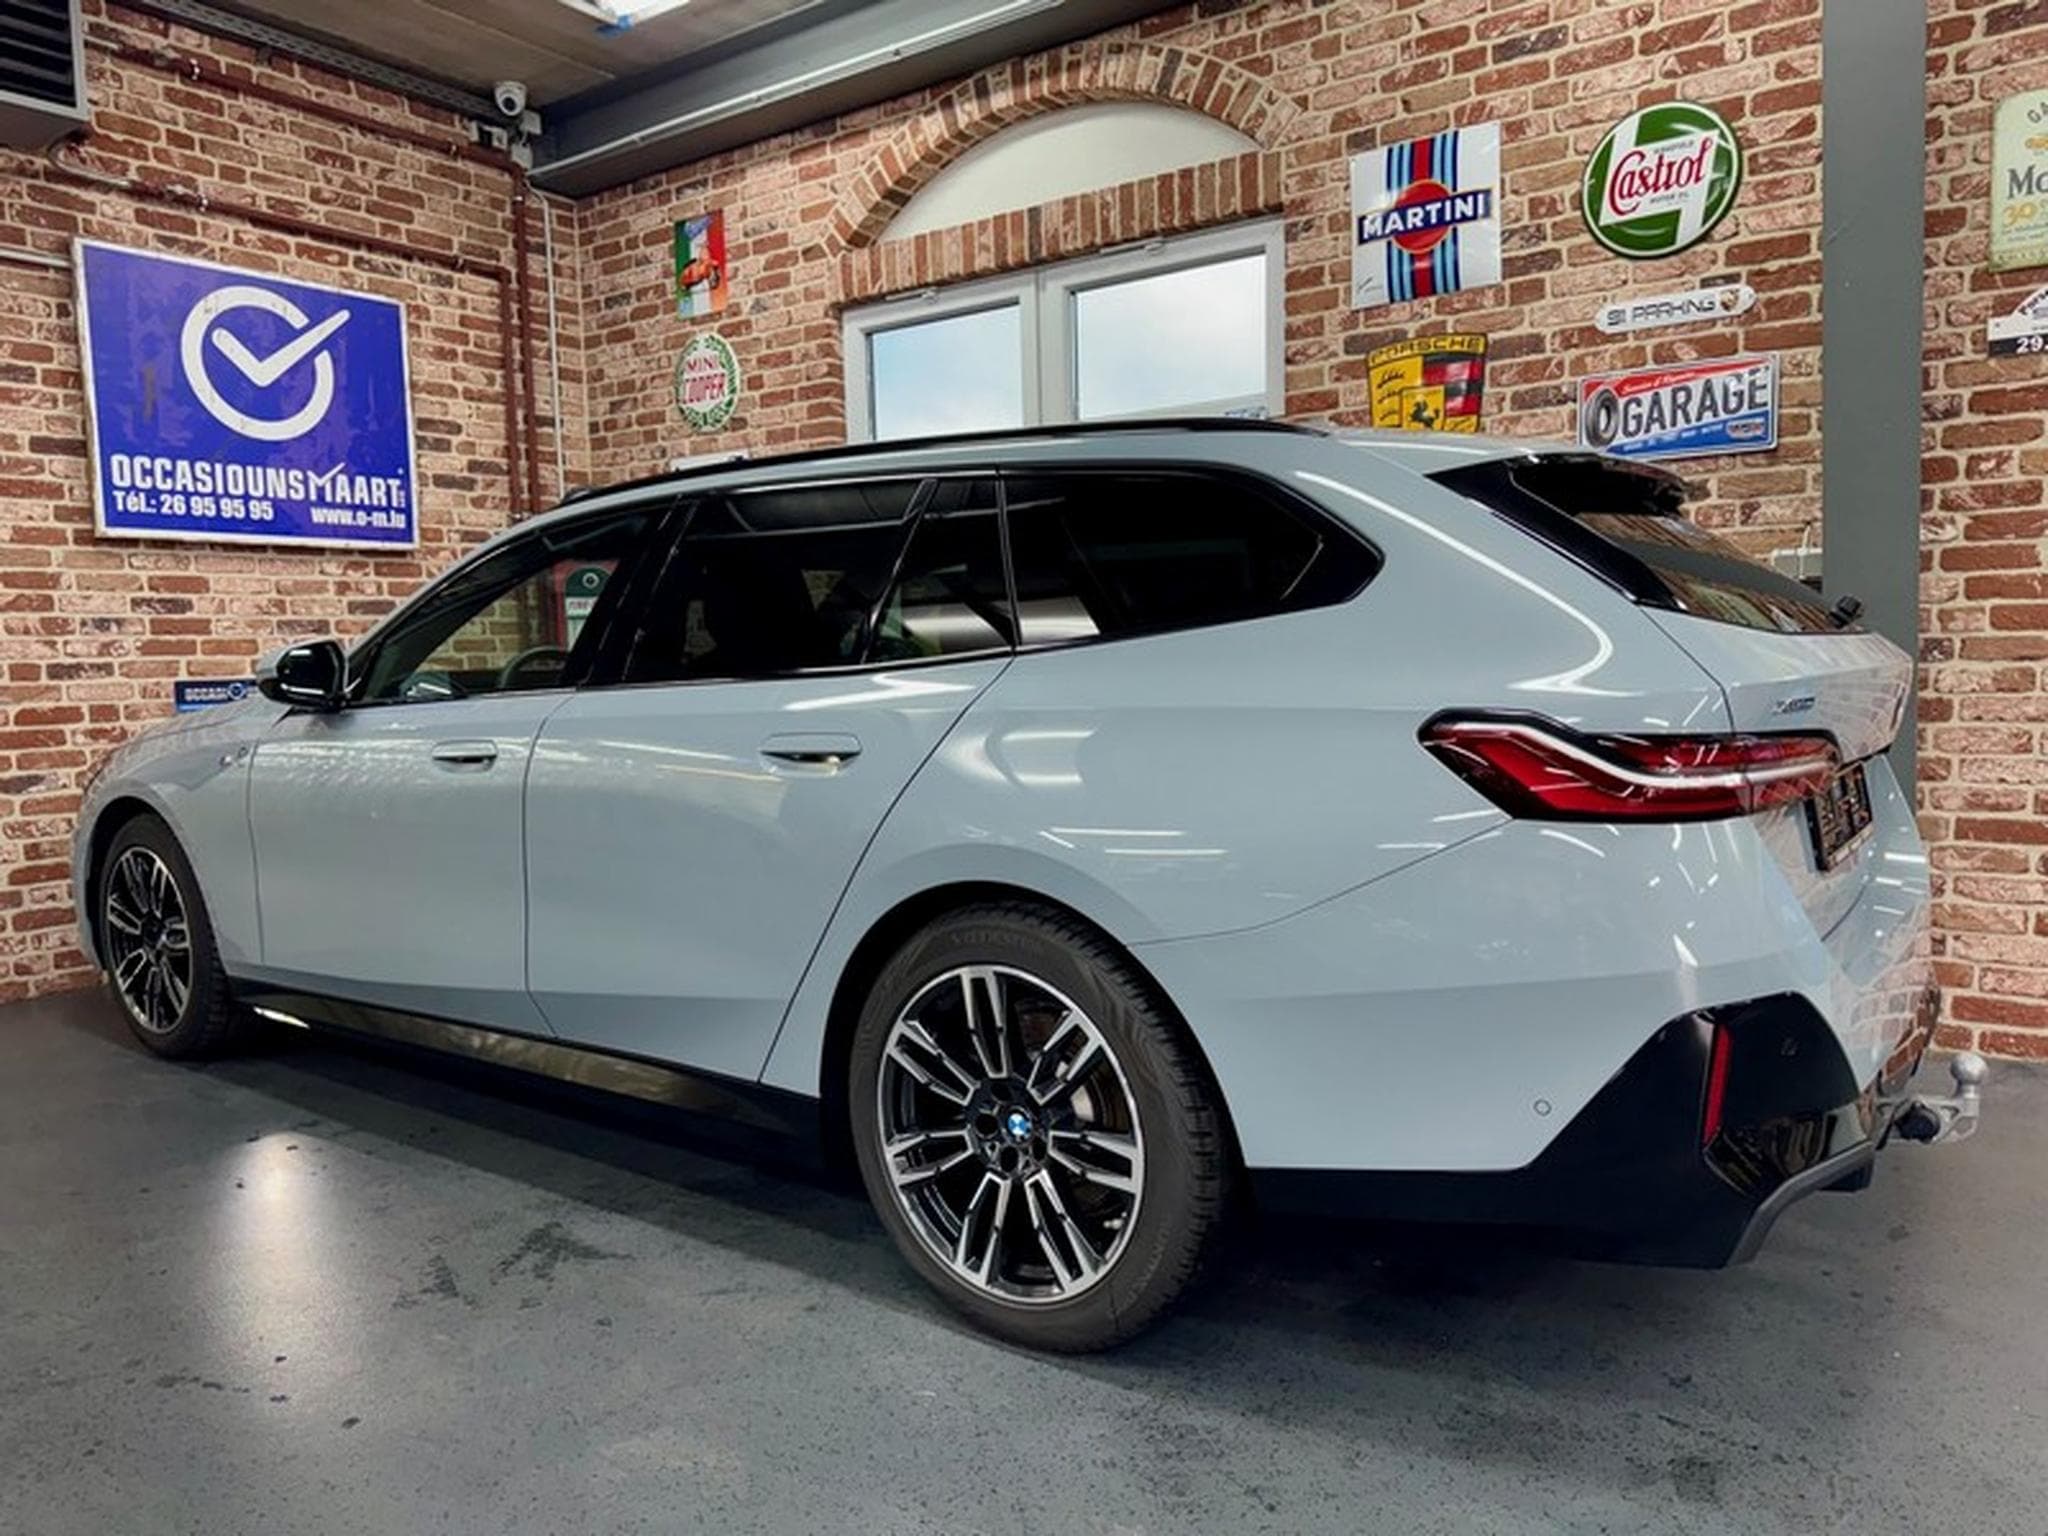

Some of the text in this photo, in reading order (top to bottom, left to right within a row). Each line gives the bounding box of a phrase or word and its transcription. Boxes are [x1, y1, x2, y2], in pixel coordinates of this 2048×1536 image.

[1609, 137, 1713, 216] Castrol
[1362, 193, 1485, 240] MARTINI
[1633, 299, 1716, 318] PARKING
[1371, 337, 1481, 365] PORSCHE
[1622, 365, 1771, 438] GARAGE
[160, 493, 187, 515] 26
[190, 495, 217, 517] 95
[220, 497, 246, 519] 95
[248, 498, 274, 521] 95
[310, 506, 406, 529] www.o-m.lu
